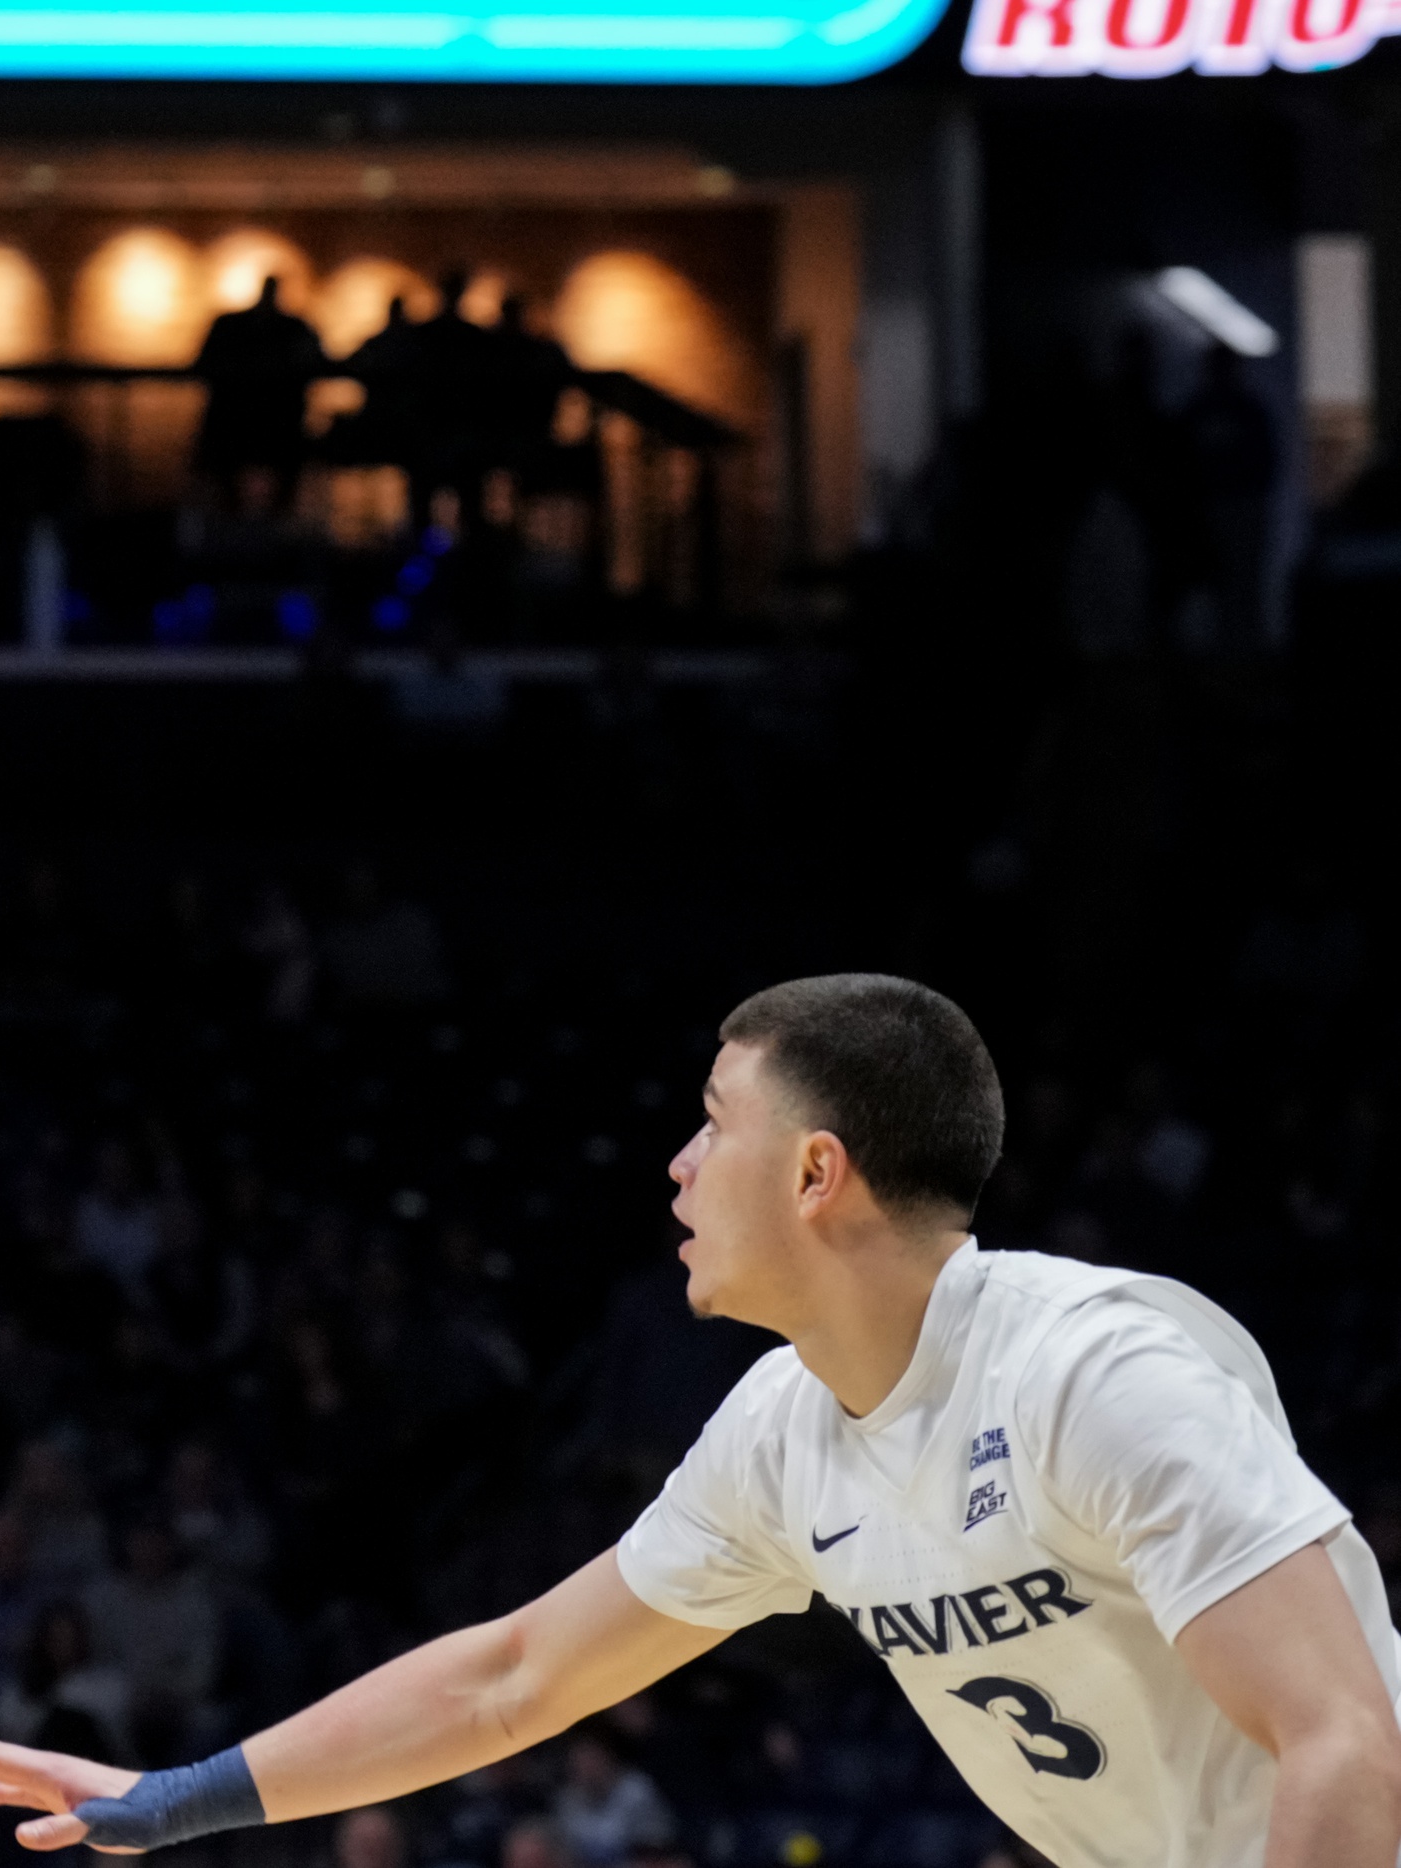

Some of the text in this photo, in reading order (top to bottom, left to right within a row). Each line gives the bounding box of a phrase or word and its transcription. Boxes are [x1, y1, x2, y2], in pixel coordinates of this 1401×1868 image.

[982, 1427, 1005, 1447] THE
[966, 1492, 1008, 1523] EAST
[969, 1480, 996, 1507] BIG
[945, 1673, 1108, 1780] 3
